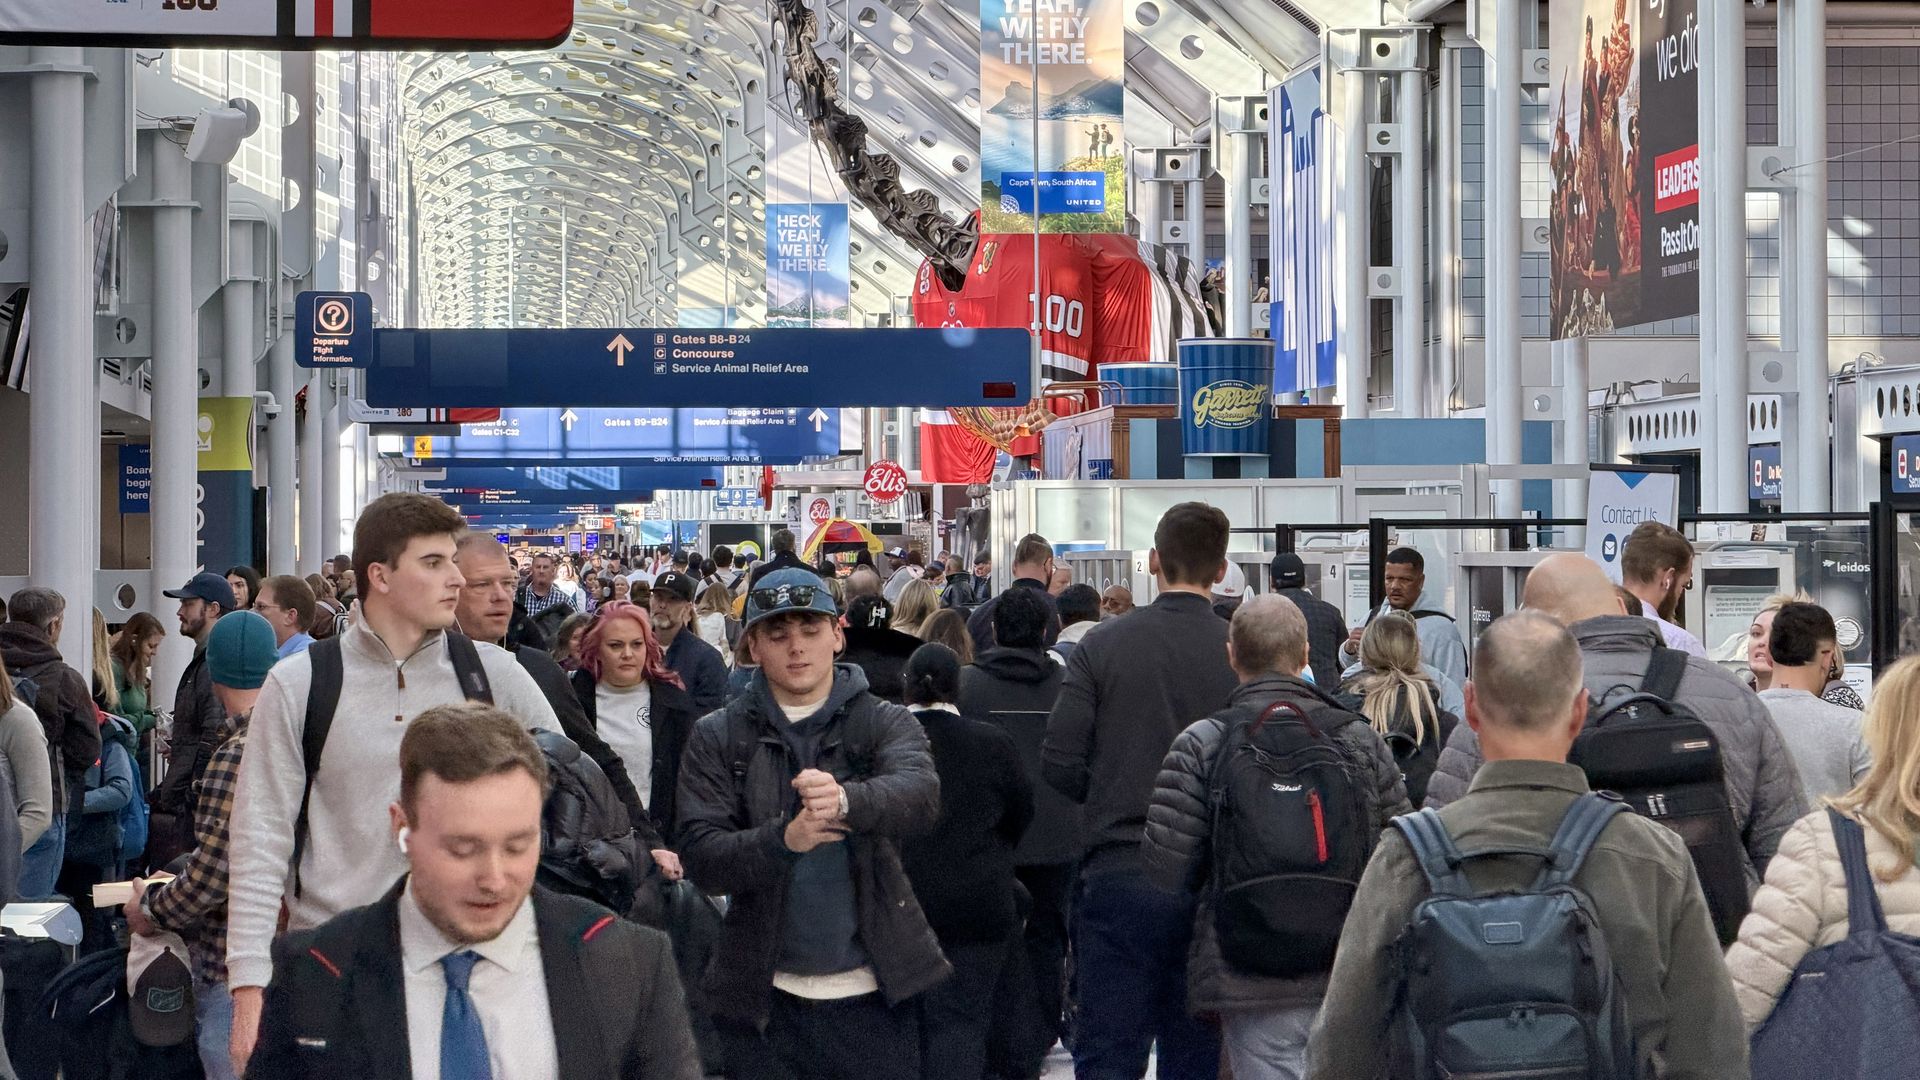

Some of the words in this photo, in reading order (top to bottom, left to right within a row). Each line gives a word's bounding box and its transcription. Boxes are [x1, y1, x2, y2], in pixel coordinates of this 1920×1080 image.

[1000, 17, 1043, 38] WE
[1050, 17, 1090, 38] FLY
[1000, 43, 1093, 64] THERE.
[1656, 33, 1678, 82] we
[1009, 179, 1029, 188] Cape
[1052, 178, 1074, 186] South
[1075, 178, 1096, 186] Africa
[777, 214, 822, 228] HECK
[777, 229, 825, 245] YEAH,
[778, 244, 802, 257] WE
[806, 244, 829, 257] FLY
[777, 259, 831, 272] THERE.
[1029, 292, 1084, 338] 100
[313, 338, 349, 346] Departure
[673, 335, 706, 344] Gates
[313, 347, 333, 355] Flight
[672, 349, 735, 359] Concourse
[313, 355, 353, 363] Information
[672, 363, 711, 373] Service
[713, 363, 749, 373] Animal
[752, 363, 783, 373] Relief
[784, 363, 809, 373] Area
[1193, 385, 1268, 428] Garrett
[604, 418, 631, 427] Gates
[634, 417, 668, 426] B9-B24
[471, 428, 493, 436] Gates
[1768, 465, 1776, 480] Do
[865, 468, 906, 492] Eli's
[126, 491, 149, 500] here
[1762, 481, 1778, 498] Security
[1601, 505, 1641, 525] Contact
[1643, 506, 1658, 522] Us
[1136, 561, 1142, 572] 2
[1330, 564, 1337, 579] 4
[1836, 561, 1871, 572] leidos
[664, 574, 676, 585] P
